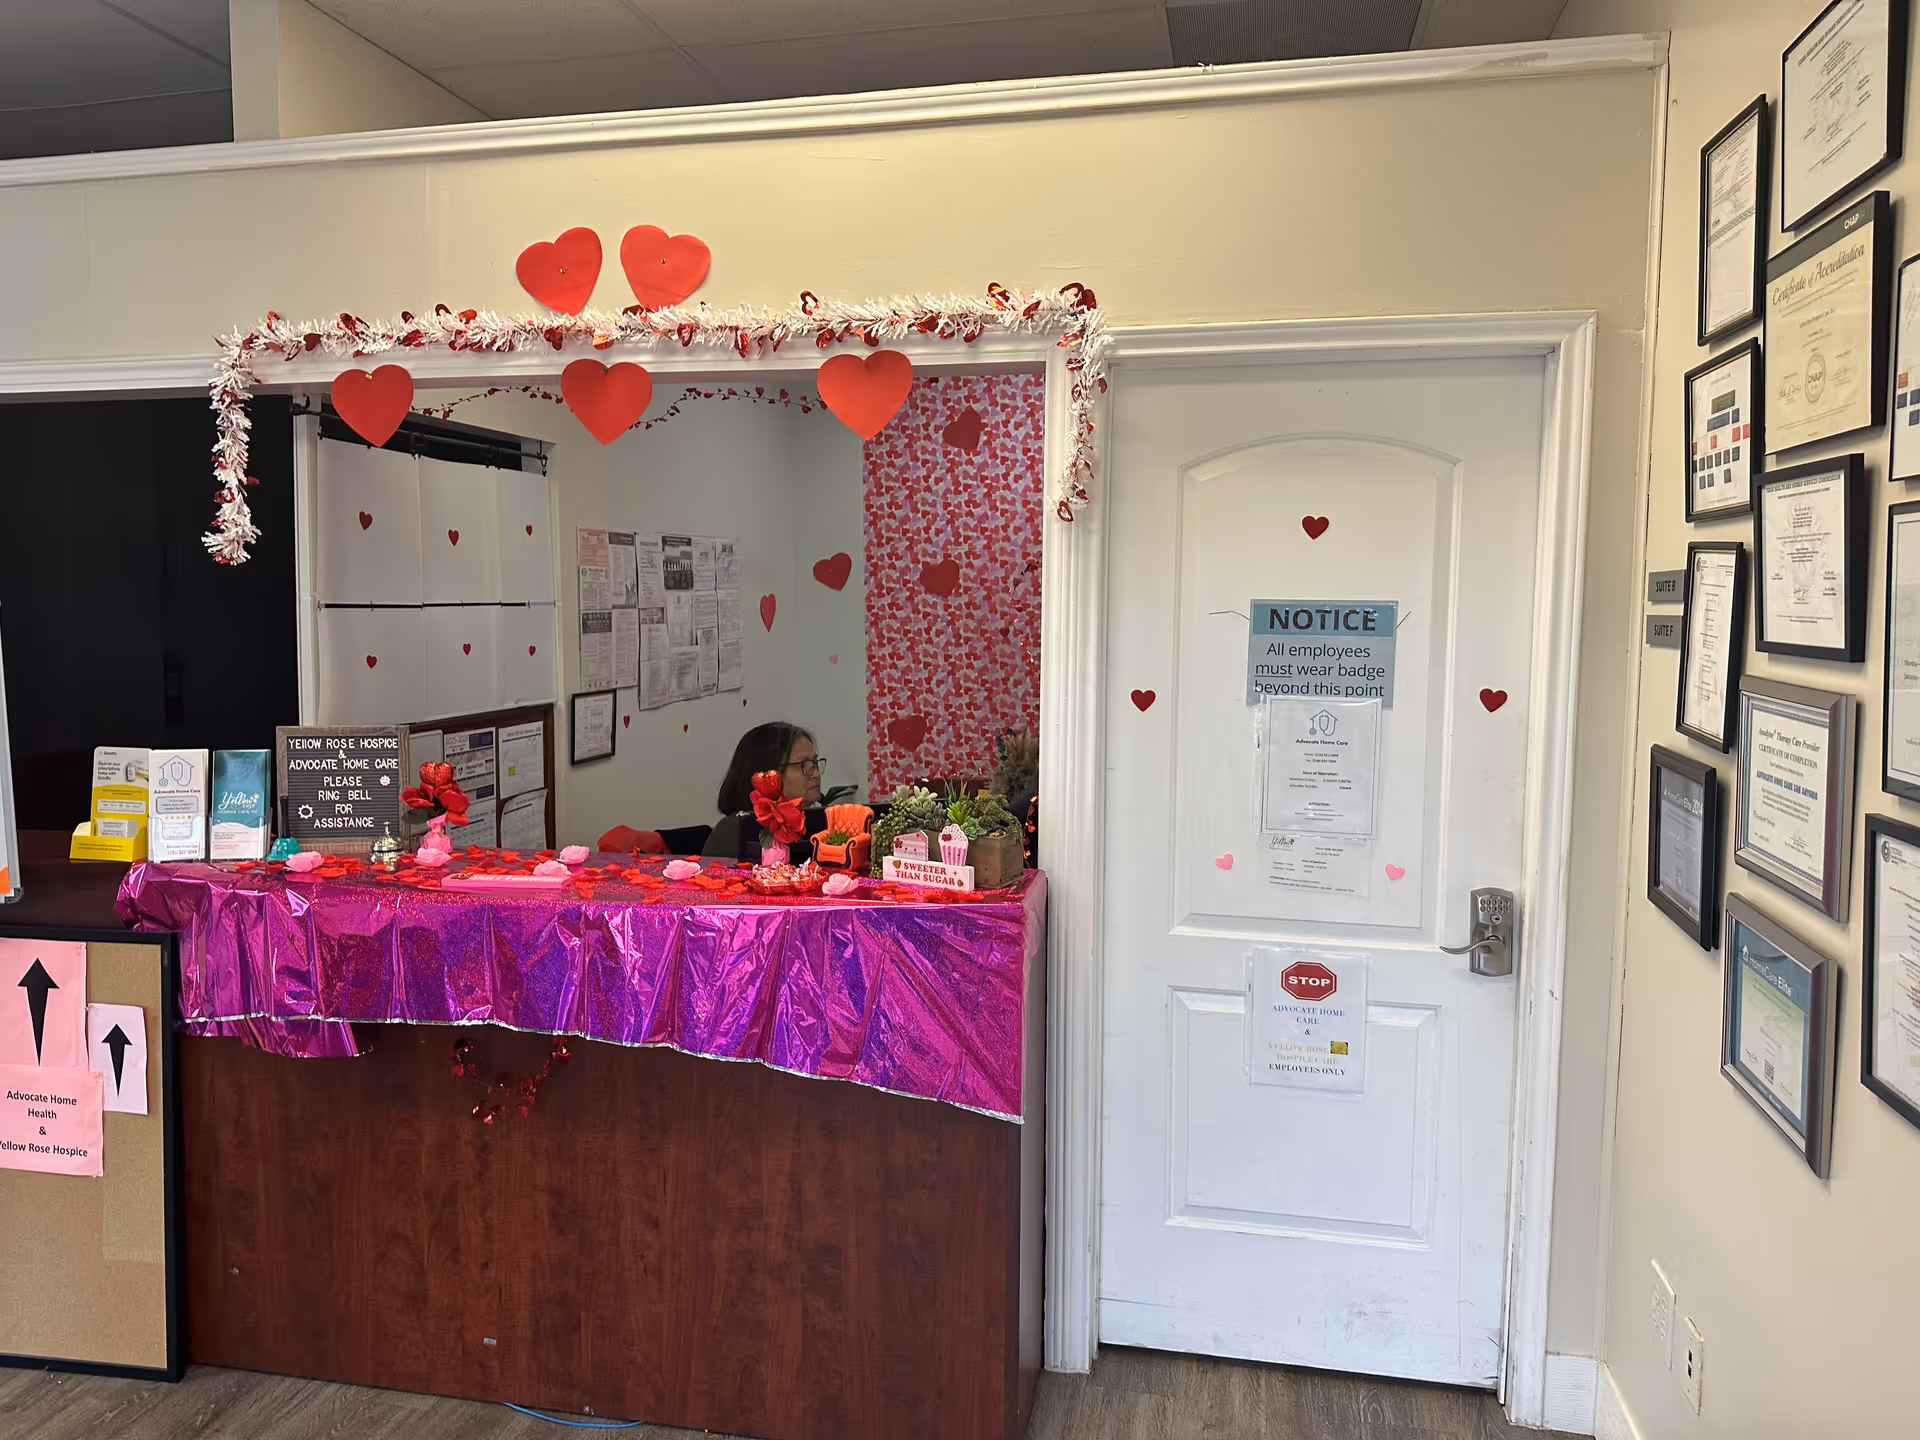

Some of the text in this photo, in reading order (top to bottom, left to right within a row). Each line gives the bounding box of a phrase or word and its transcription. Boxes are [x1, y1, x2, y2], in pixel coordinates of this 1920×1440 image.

[1844, 213, 1860, 229] CHAP
[1772, 276, 1806, 306] Certificate
[1814, 243, 1865, 281] Accreditation
[1807, 371, 1823, 384] CHAP
[1655, 579, 1676, 592] SUITE B
[1269, 608, 1377, 632] NOTICE
[1654, 624, 1674, 637] SUITE F
[1267, 642, 1371, 661] All employees
[1255, 663, 1385, 681] must wear badge
[1254, 680, 1385, 698] beyond this point
[326, 738, 355, 749] ROSE
[360, 738, 399, 749] HOSPICE
[1776, 731, 1791, 746] Therapy
[1791, 736, 1802, 748] Care
[1802, 739, 1820, 753] Provider
[338, 749, 347, 759] &
[1758, 743, 1783, 758] CERTIFICATE
[1790, 752, 1818, 769] COMPLETION
[288, 758, 399, 770] ADVOCATE HOME CARE
[323, 776, 362, 787] PLEASE
[218, 791, 255, 810] Yellow
[318, 789, 372, 801] RING BELL
[335, 803, 353, 814] FOR
[313, 817, 375, 829] ASSISTANCE
[903, 862, 947, 875] SWEETER
[895, 870, 955, 886] THAN SUGAR
[1288, 975, 1330, 987] STOP
[1749, 956, 1792, 997] HomeCare Elite
[1272, 1004, 1345, 1017] ADVOCATE HOME
[1296, 1016, 1320, 1025] CARE
[1304, 1028, 1311, 1036] &
[1268, 1042, 1329, 1054] YELLOW ROSE
[1269, 1063, 1346, 1076] EMPLOYEES ONLY
[6, 1090, 77, 1106] Advocate Home
[27, 1108, 57, 1120] Health
[38, 1125, 47, 1136] &
[28, 1142, 50, 1154] Rose
[52, 1145, 88, 1158] Hospice
